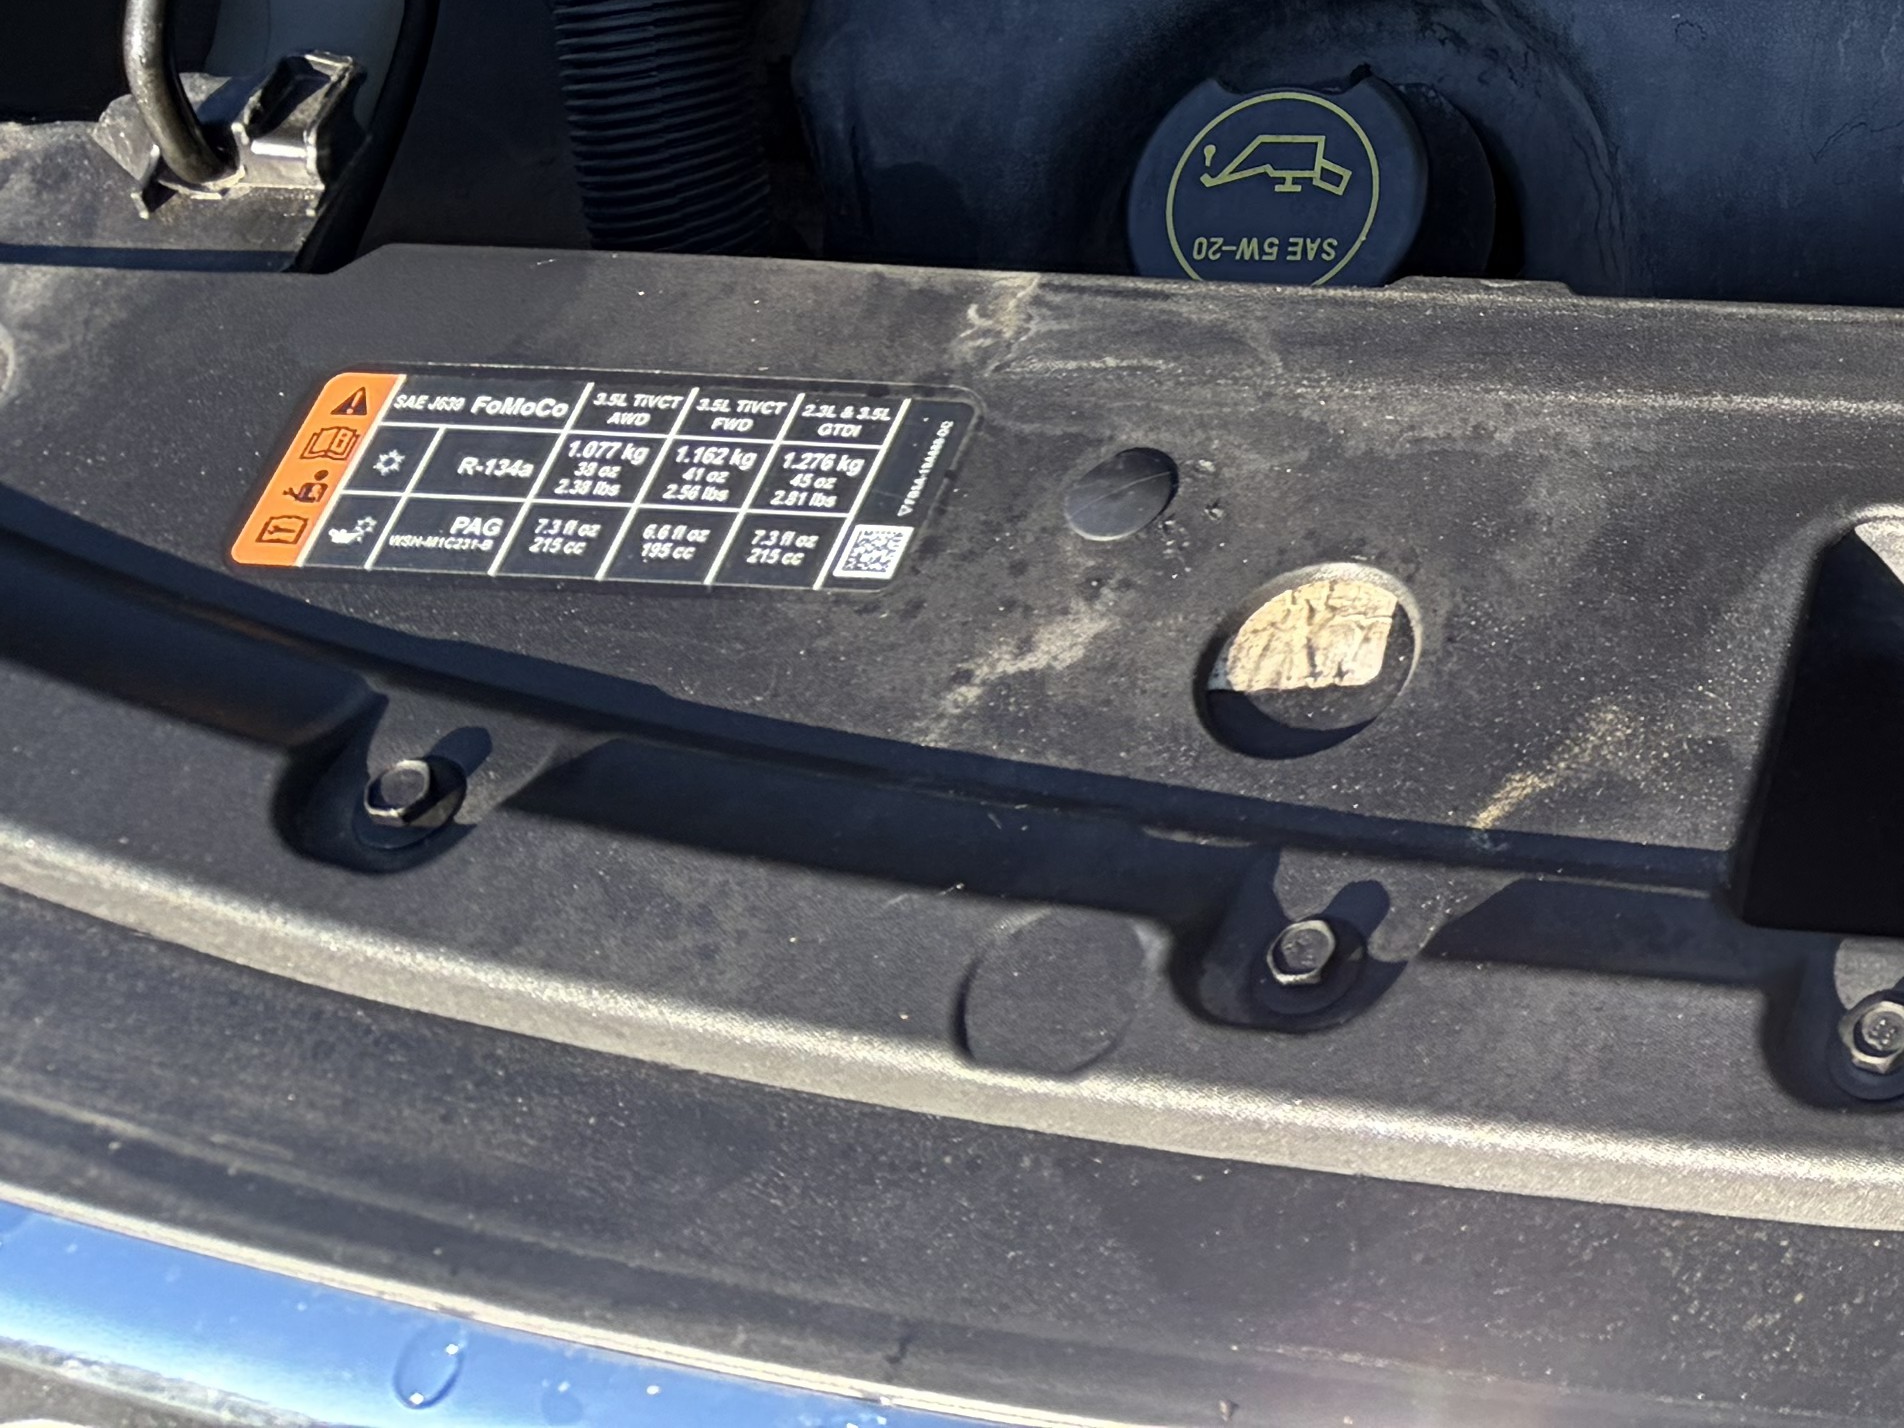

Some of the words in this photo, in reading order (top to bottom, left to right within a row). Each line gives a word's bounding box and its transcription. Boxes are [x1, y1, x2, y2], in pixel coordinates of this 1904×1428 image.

[1192, 237, 1279, 262] 5W-20
[1287, 237, 1338, 262] SAE
[393, 394, 429, 411] SAE
[470, 395, 569, 418] FoMoCo
[593, 392, 628, 407] 3.5L
[696, 398, 731, 413] 3.5L
[607, 412, 651, 427] AWD
[802, 404, 837, 419] 2.3L
[840, 406, 855, 420] &
[856, 407, 891, 422] 3.5L
[711, 417, 754, 432] FWD
[568, 440, 623, 460] 1.077
[621, 443, 650, 466] kg
[675, 445, 730, 466] 1.162
[729, 448, 758, 471] kg
[457, 456, 534, 478] R-134a
[598, 466, 621, 478] oz
[782, 451, 837, 471] 1.276
[836, 455, 865, 477] kg
[682, 467, 704, 481] 41
[706, 471, 730, 484] oz
[789, 473, 814, 488] 45
[813, 477, 837, 490] oz
[593, 480, 621, 496] lbs
[662, 484, 702, 500] 2.56
[702, 486, 729, 502] lbs
[770, 490, 808, 506] 2.81
[809, 493, 837, 508] lbs
[450, 516, 504, 537] PAG
[534, 518, 562, 535] 7.3
[578, 524, 601, 538] oz
[642, 524, 671, 540] 6.6
[686, 529, 711, 543] oz
[529, 537, 563, 554] 215
[563, 541, 586, 555] cc
[751, 529, 780, 545] 7.3
[795, 535, 819, 548] oz
[641, 542, 672, 558] 195
[672, 546, 696, 560] cc
[746, 548, 780, 563] 215
[781, 552, 804, 566] cc
